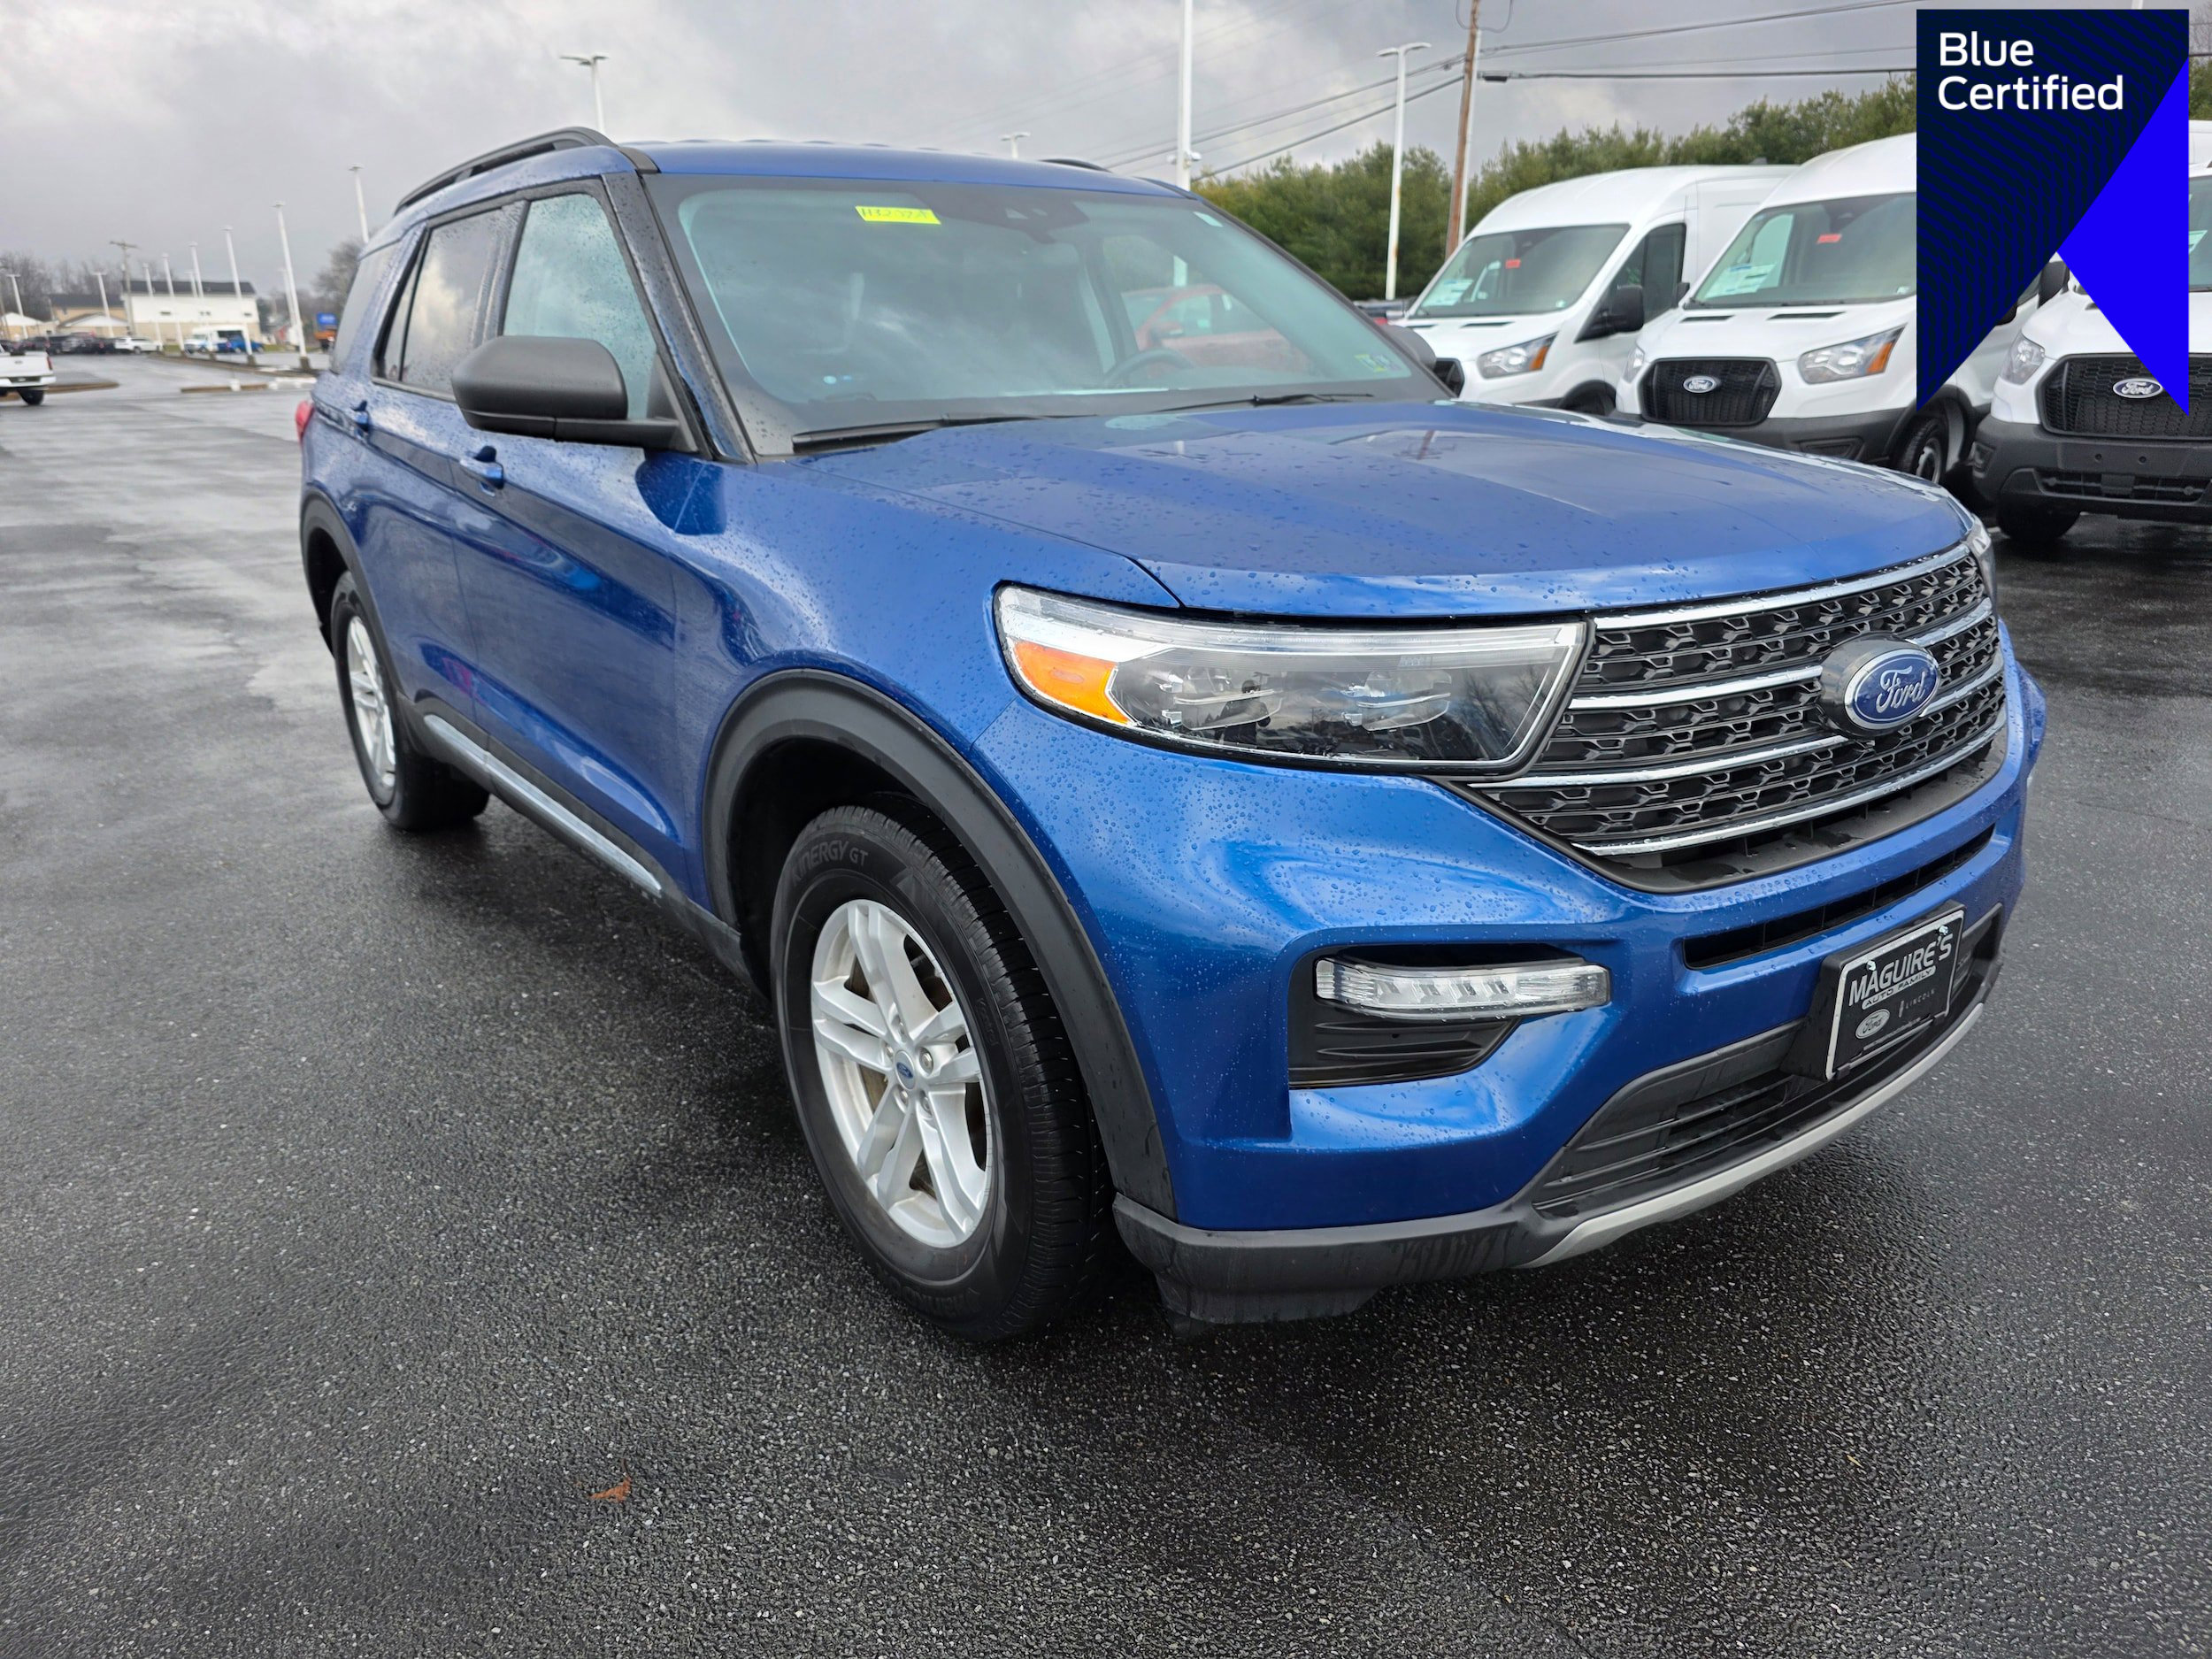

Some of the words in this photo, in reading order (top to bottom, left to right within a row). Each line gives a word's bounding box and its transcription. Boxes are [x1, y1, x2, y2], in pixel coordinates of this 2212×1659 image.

[2122, 381, 2154, 395] Ford
[1876, 665, 1926, 713] Ford
[849, 847, 869, 867] GT
[1848, 933, 1954, 1006] MAGUIRE'S
[1865, 987, 1894, 1007] AUTO
[1897, 969, 1932, 991] FAMILY
